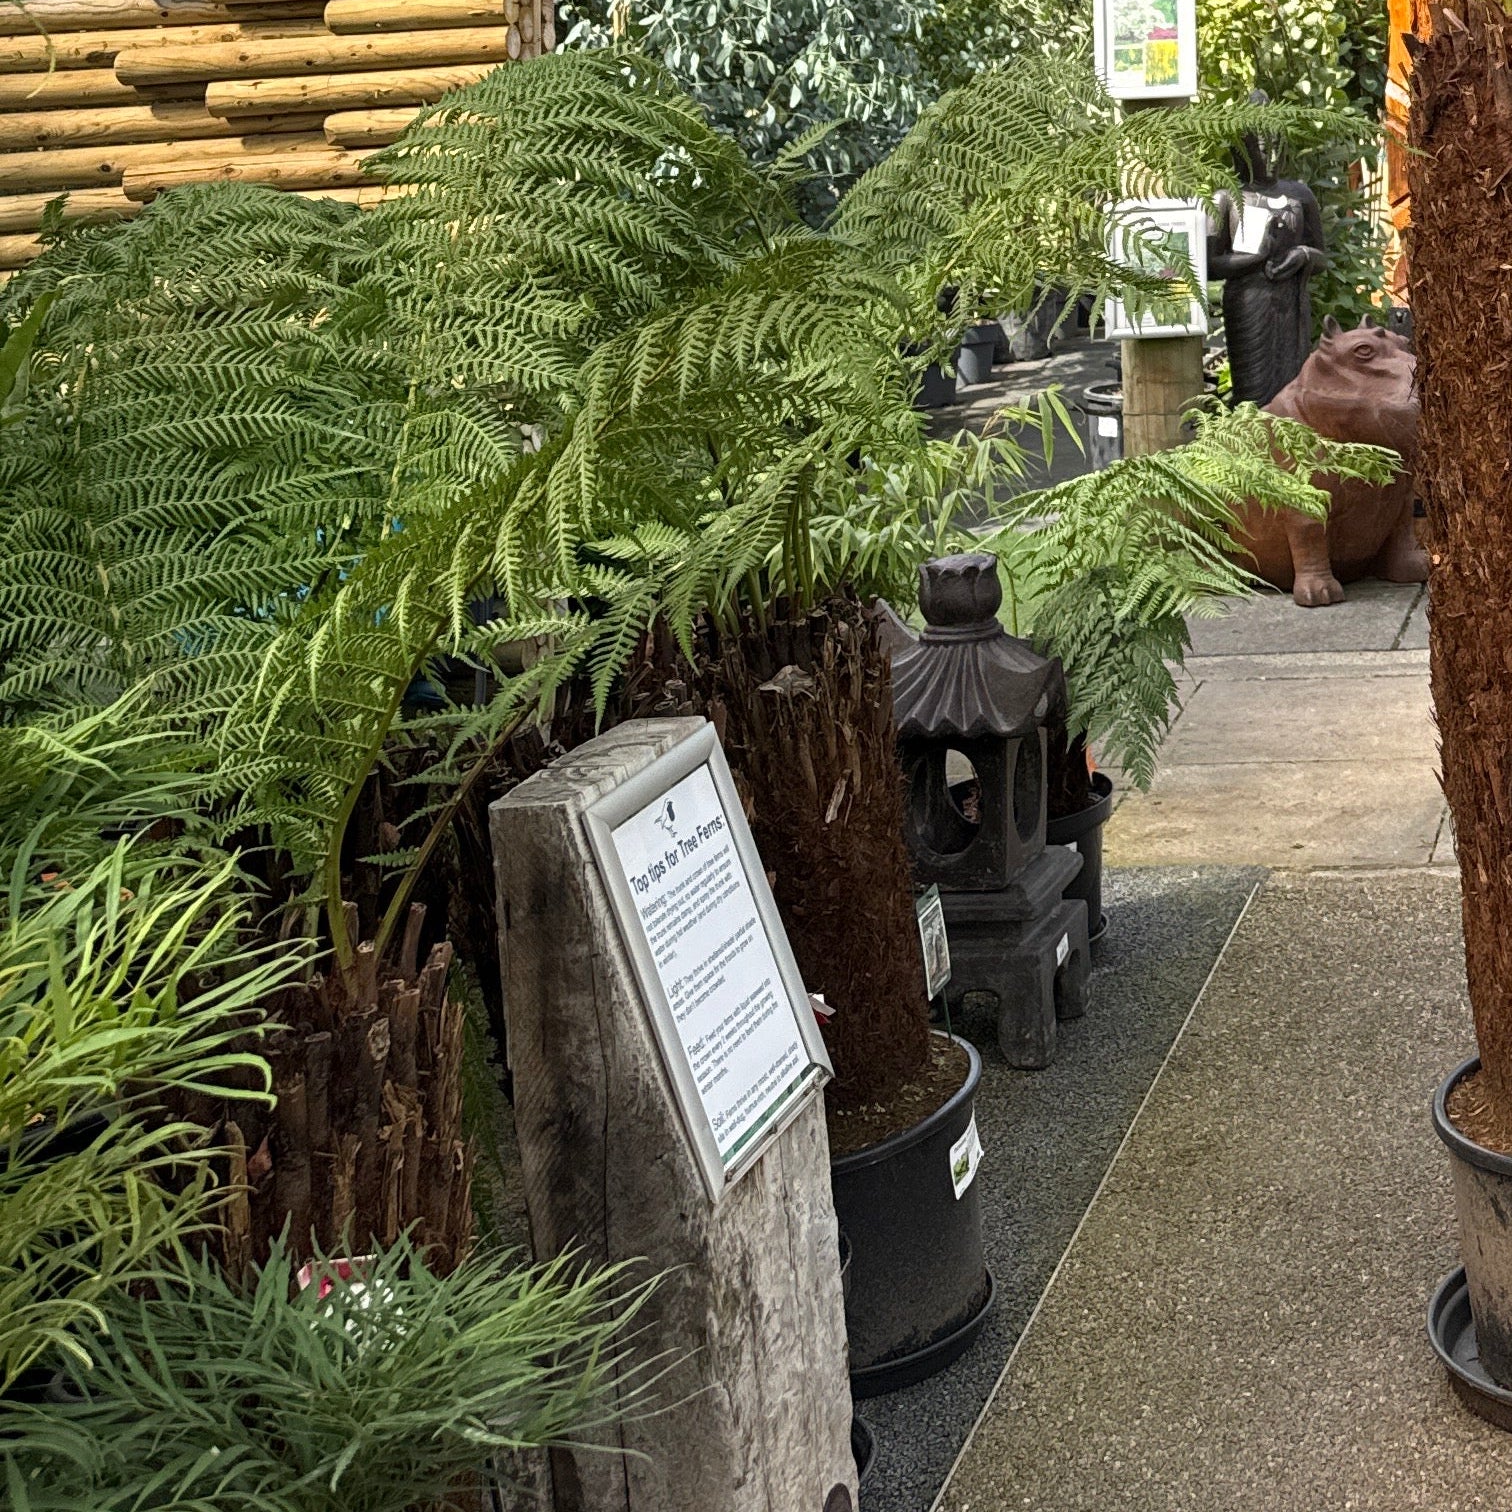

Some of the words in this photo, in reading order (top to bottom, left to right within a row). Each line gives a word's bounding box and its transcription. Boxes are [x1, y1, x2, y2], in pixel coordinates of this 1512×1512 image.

[630, 874, 649, 895] Top
[648, 860, 666, 883] tips
[664, 849, 679, 869] for
[677, 835, 698, 858] Tree
[696, 814, 725, 844] Ferns:
